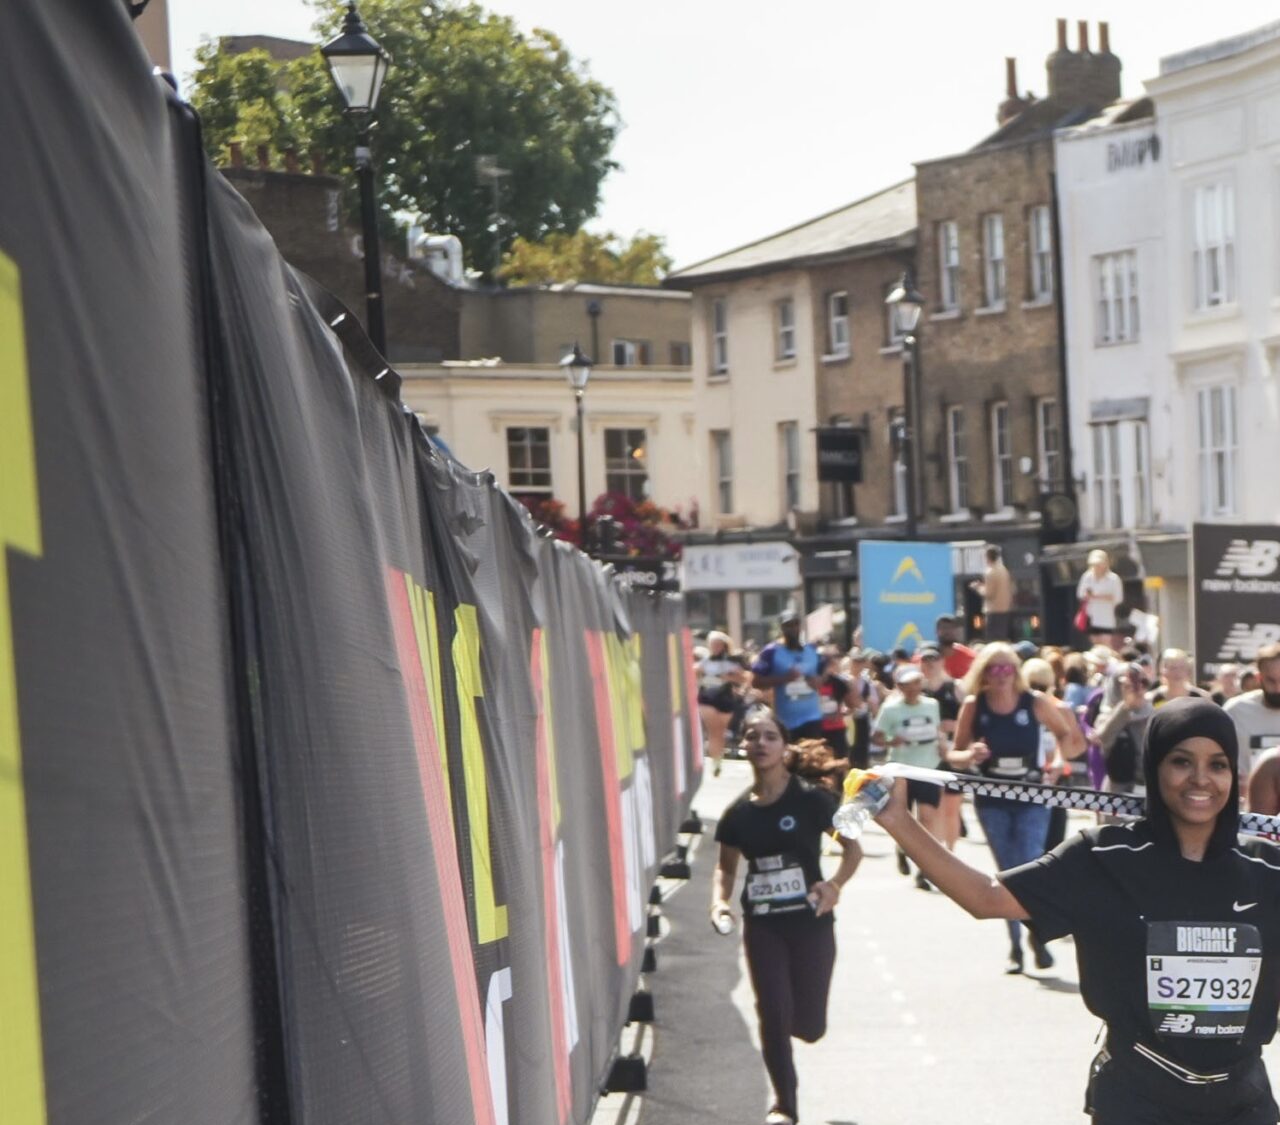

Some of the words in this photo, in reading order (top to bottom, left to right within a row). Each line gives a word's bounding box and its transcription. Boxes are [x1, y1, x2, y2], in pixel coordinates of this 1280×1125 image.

[1201, 579, 1232, 592] new
[1157, 976, 1252, 1000] S27932
[1195, 1026, 1216, 1034] new
[1217, 1024, 1246, 1035] balanc
